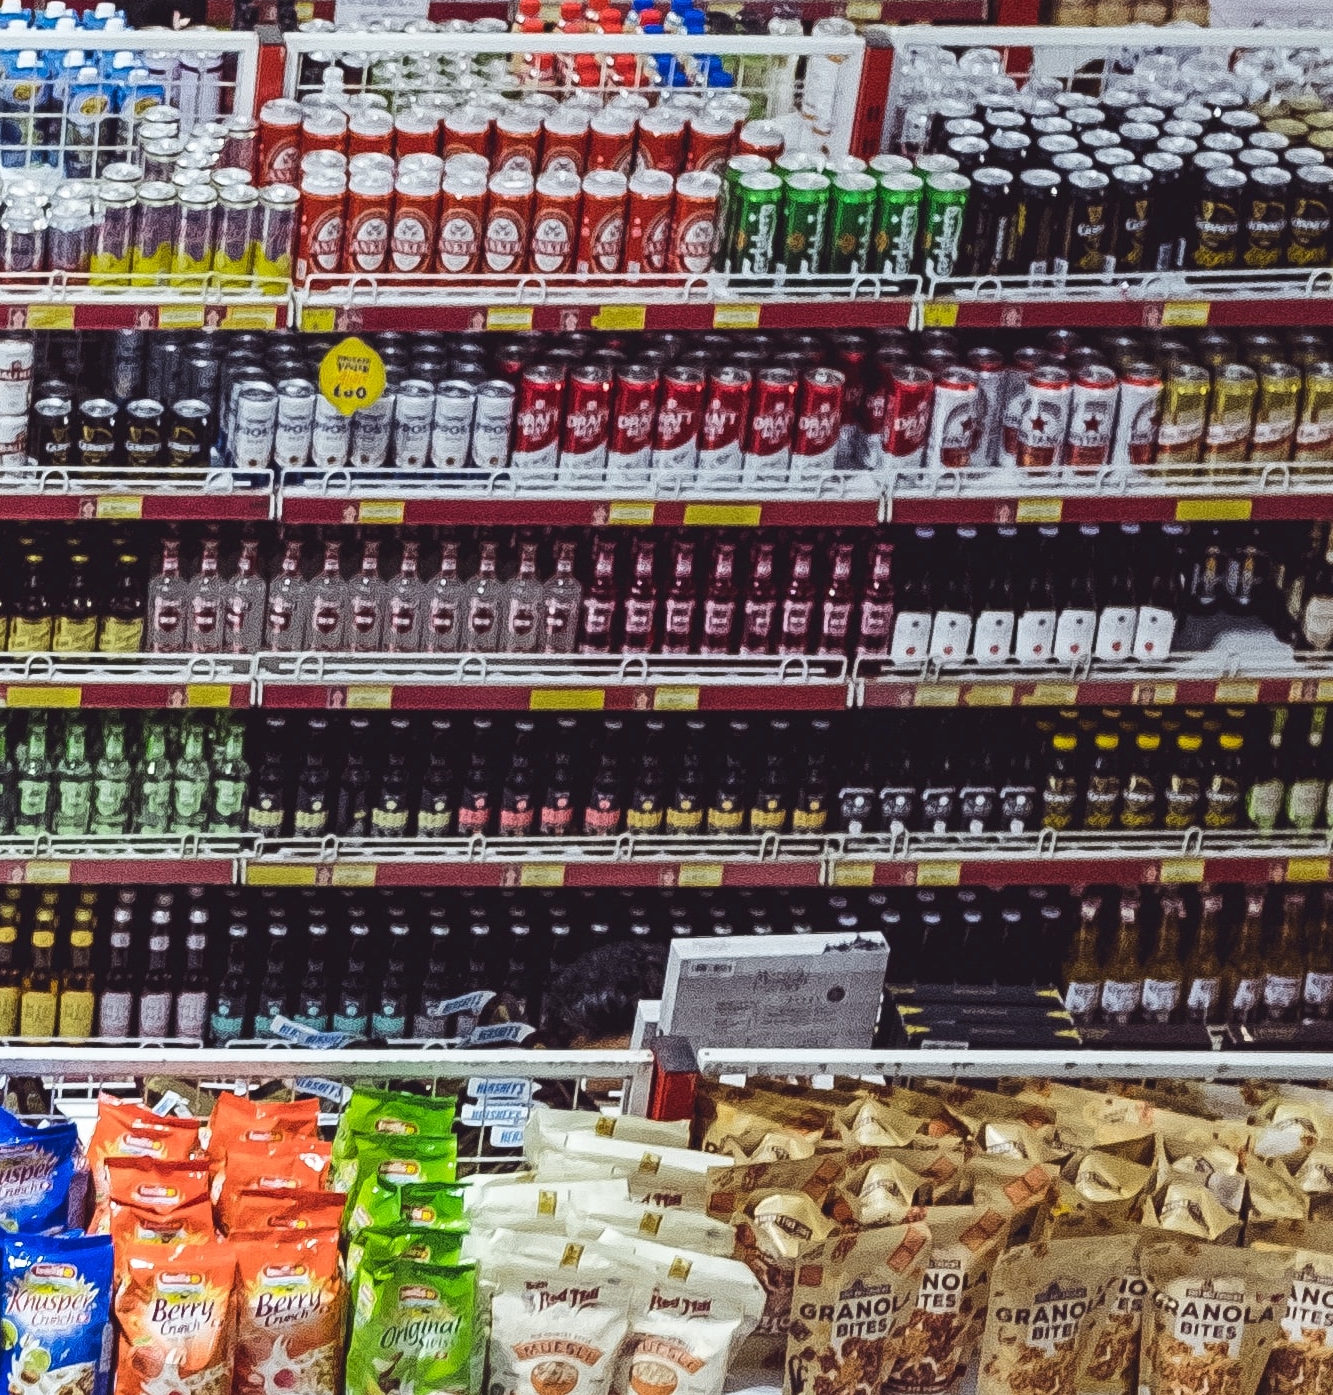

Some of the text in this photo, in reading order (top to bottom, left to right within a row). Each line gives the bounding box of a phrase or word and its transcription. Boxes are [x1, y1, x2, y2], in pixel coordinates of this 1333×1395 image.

[6, 1292, 95, 1314] Knusper
[151, 1298, 216, 1327] Berry
[255, 1292, 323, 1319] Berry
[1153, 1292, 1275, 1323] GRANOLA
[160, 1317, 202, 1336] Crunch
[265, 1309, 310, 1328] Crunch
[1180, 1321, 1238, 1339] BITES
[379, 1317, 462, 1350] Original
